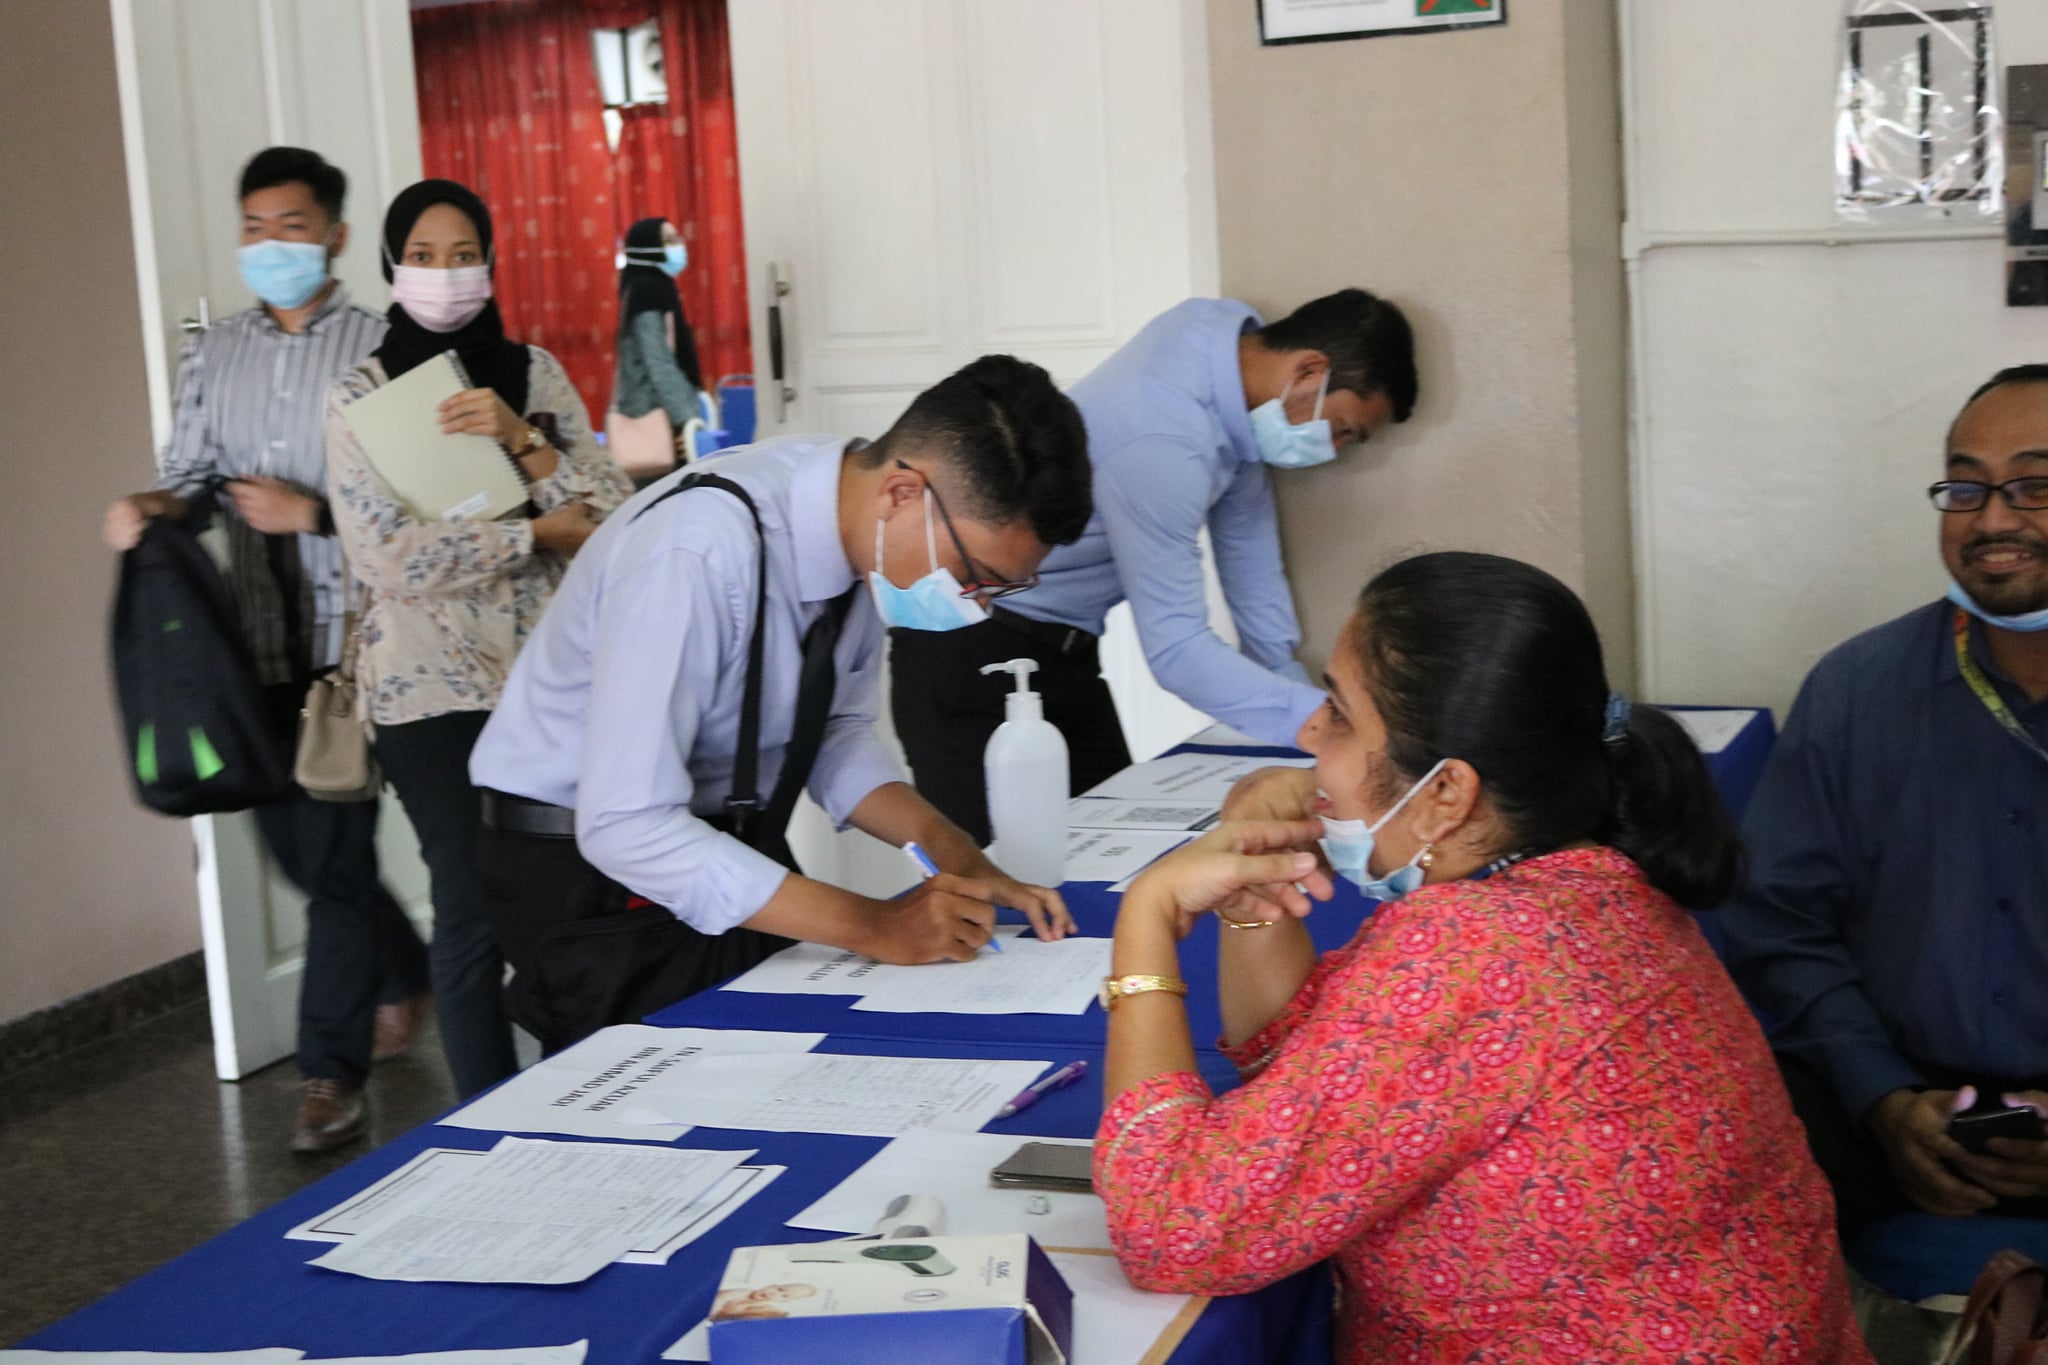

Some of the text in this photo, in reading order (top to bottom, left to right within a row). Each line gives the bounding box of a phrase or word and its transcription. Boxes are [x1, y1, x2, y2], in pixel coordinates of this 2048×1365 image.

[549, 1046, 664, 1107] BIN AHMAD JADI
[582, 1046, 703, 1112] EN. SAIFUL AZUAR
